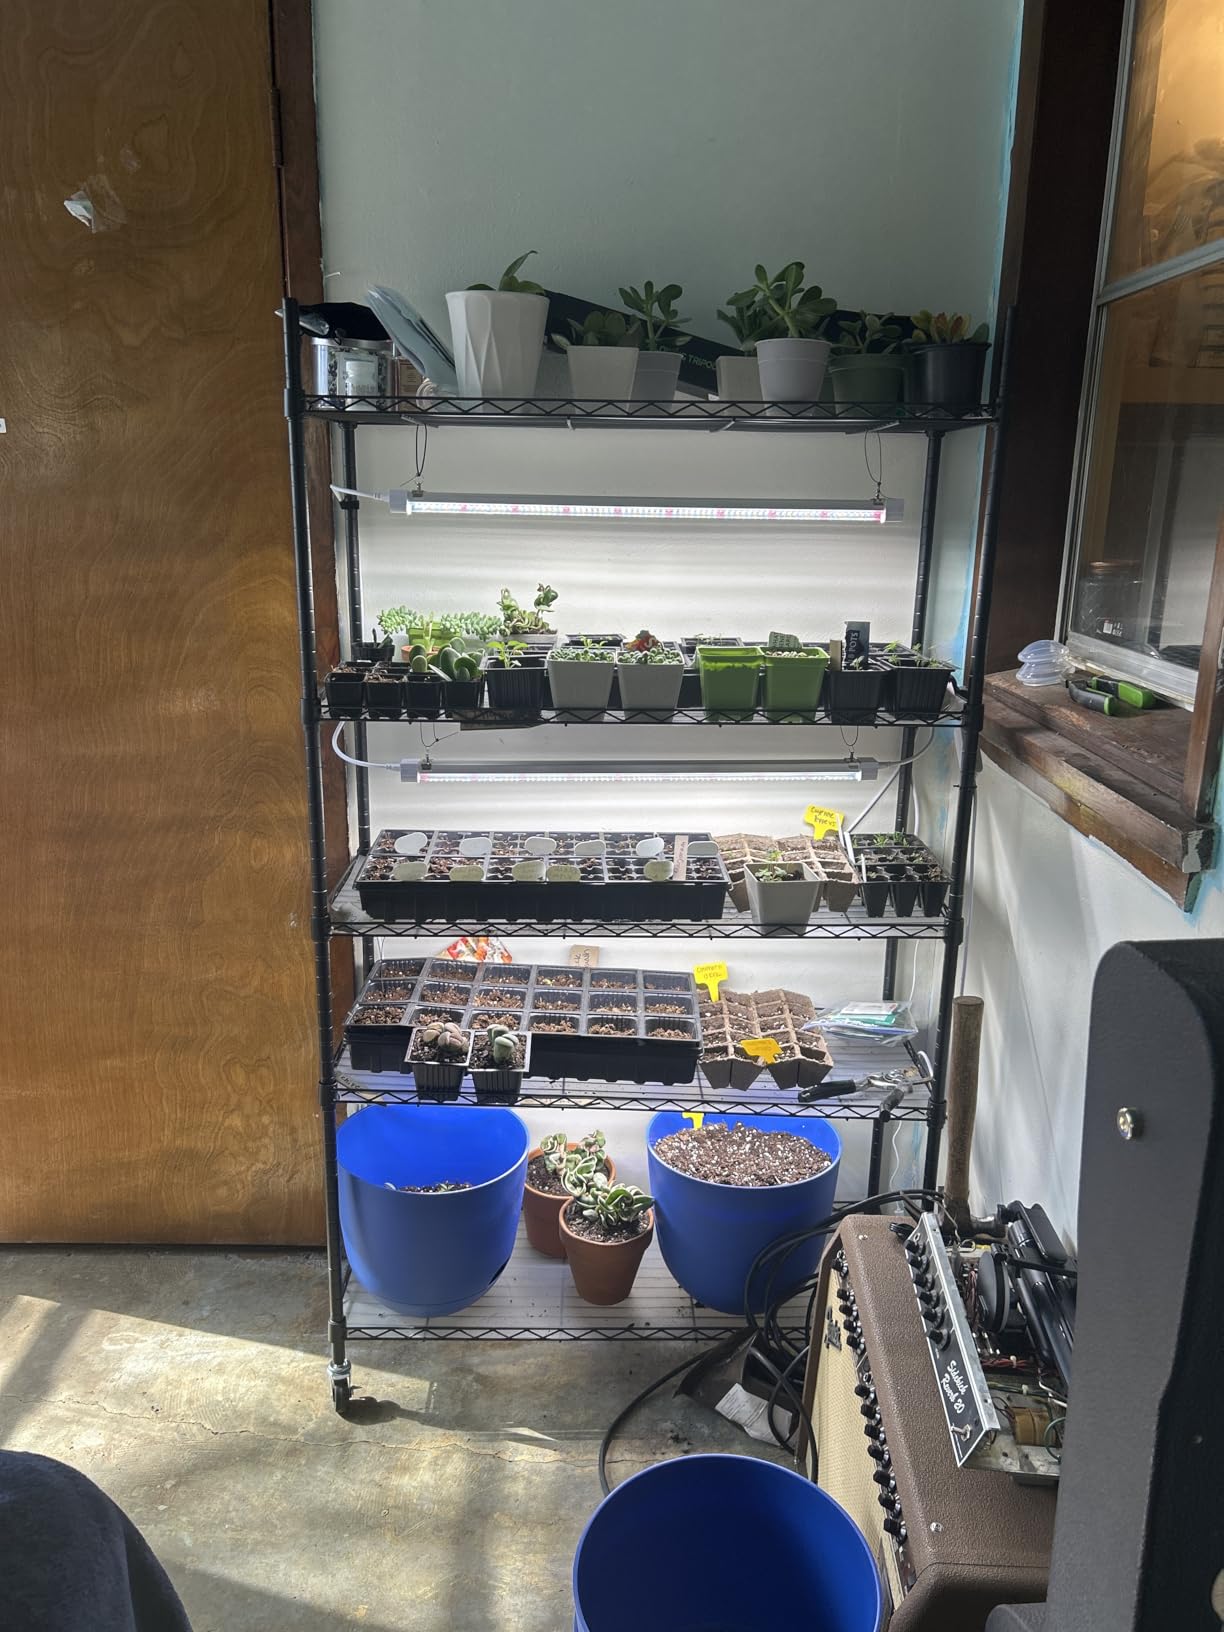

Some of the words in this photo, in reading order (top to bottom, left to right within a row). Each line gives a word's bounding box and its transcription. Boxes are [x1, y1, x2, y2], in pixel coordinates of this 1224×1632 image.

[849, 632, 858, 653] POTS
[941, 1373, 959, 1402] Reverb
[953, 1398, 965, 1413] 20
[947, 1360, 968, 1395] Sidekick
